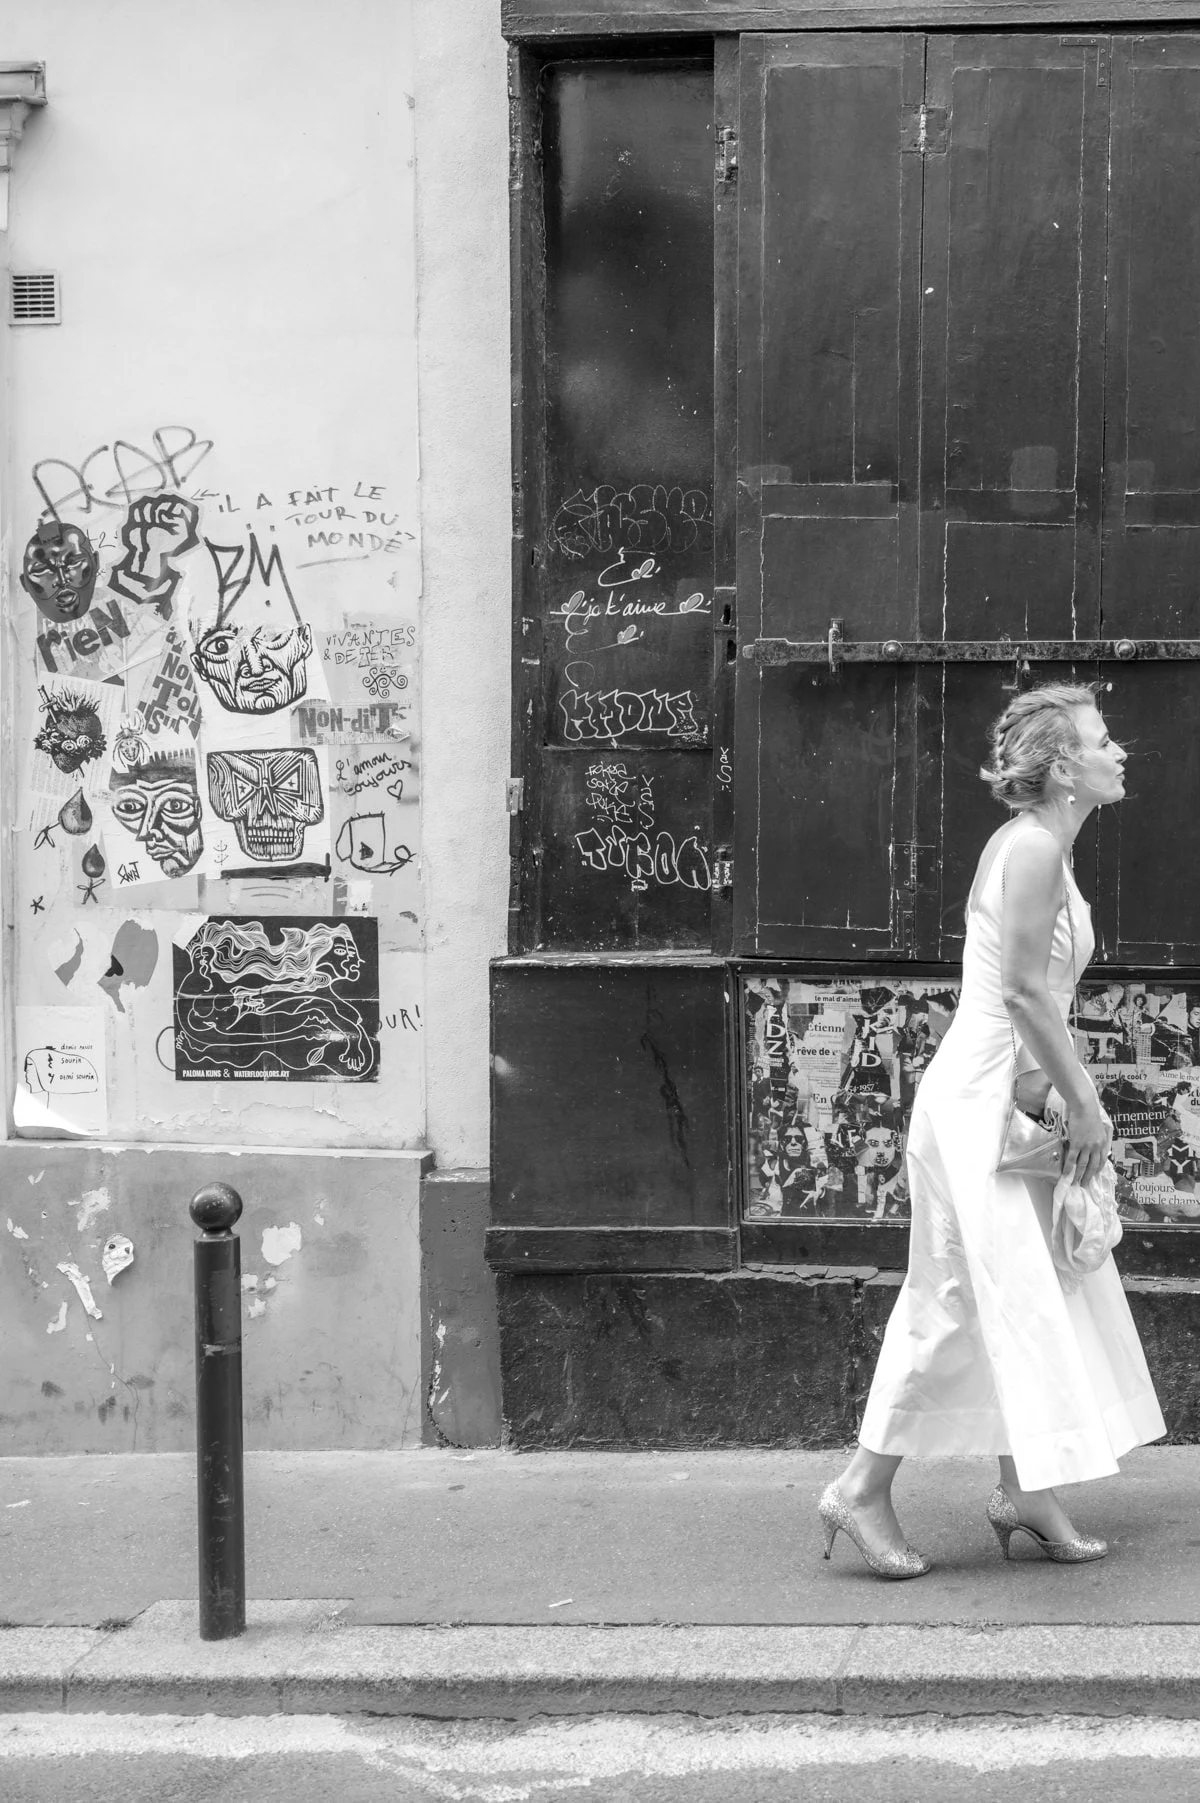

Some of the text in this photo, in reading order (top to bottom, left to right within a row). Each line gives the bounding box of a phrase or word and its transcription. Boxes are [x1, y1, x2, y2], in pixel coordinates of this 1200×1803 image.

[285, 506, 356, 527] TOUR
[380, 1004, 423, 1031] UR!
[818, 1047, 830, 1056] de
[182, 1069, 205, 1078] PALOMA
[223, 1068, 230, 1078] &
[1134, 1181, 1175, 1195] Toujours
